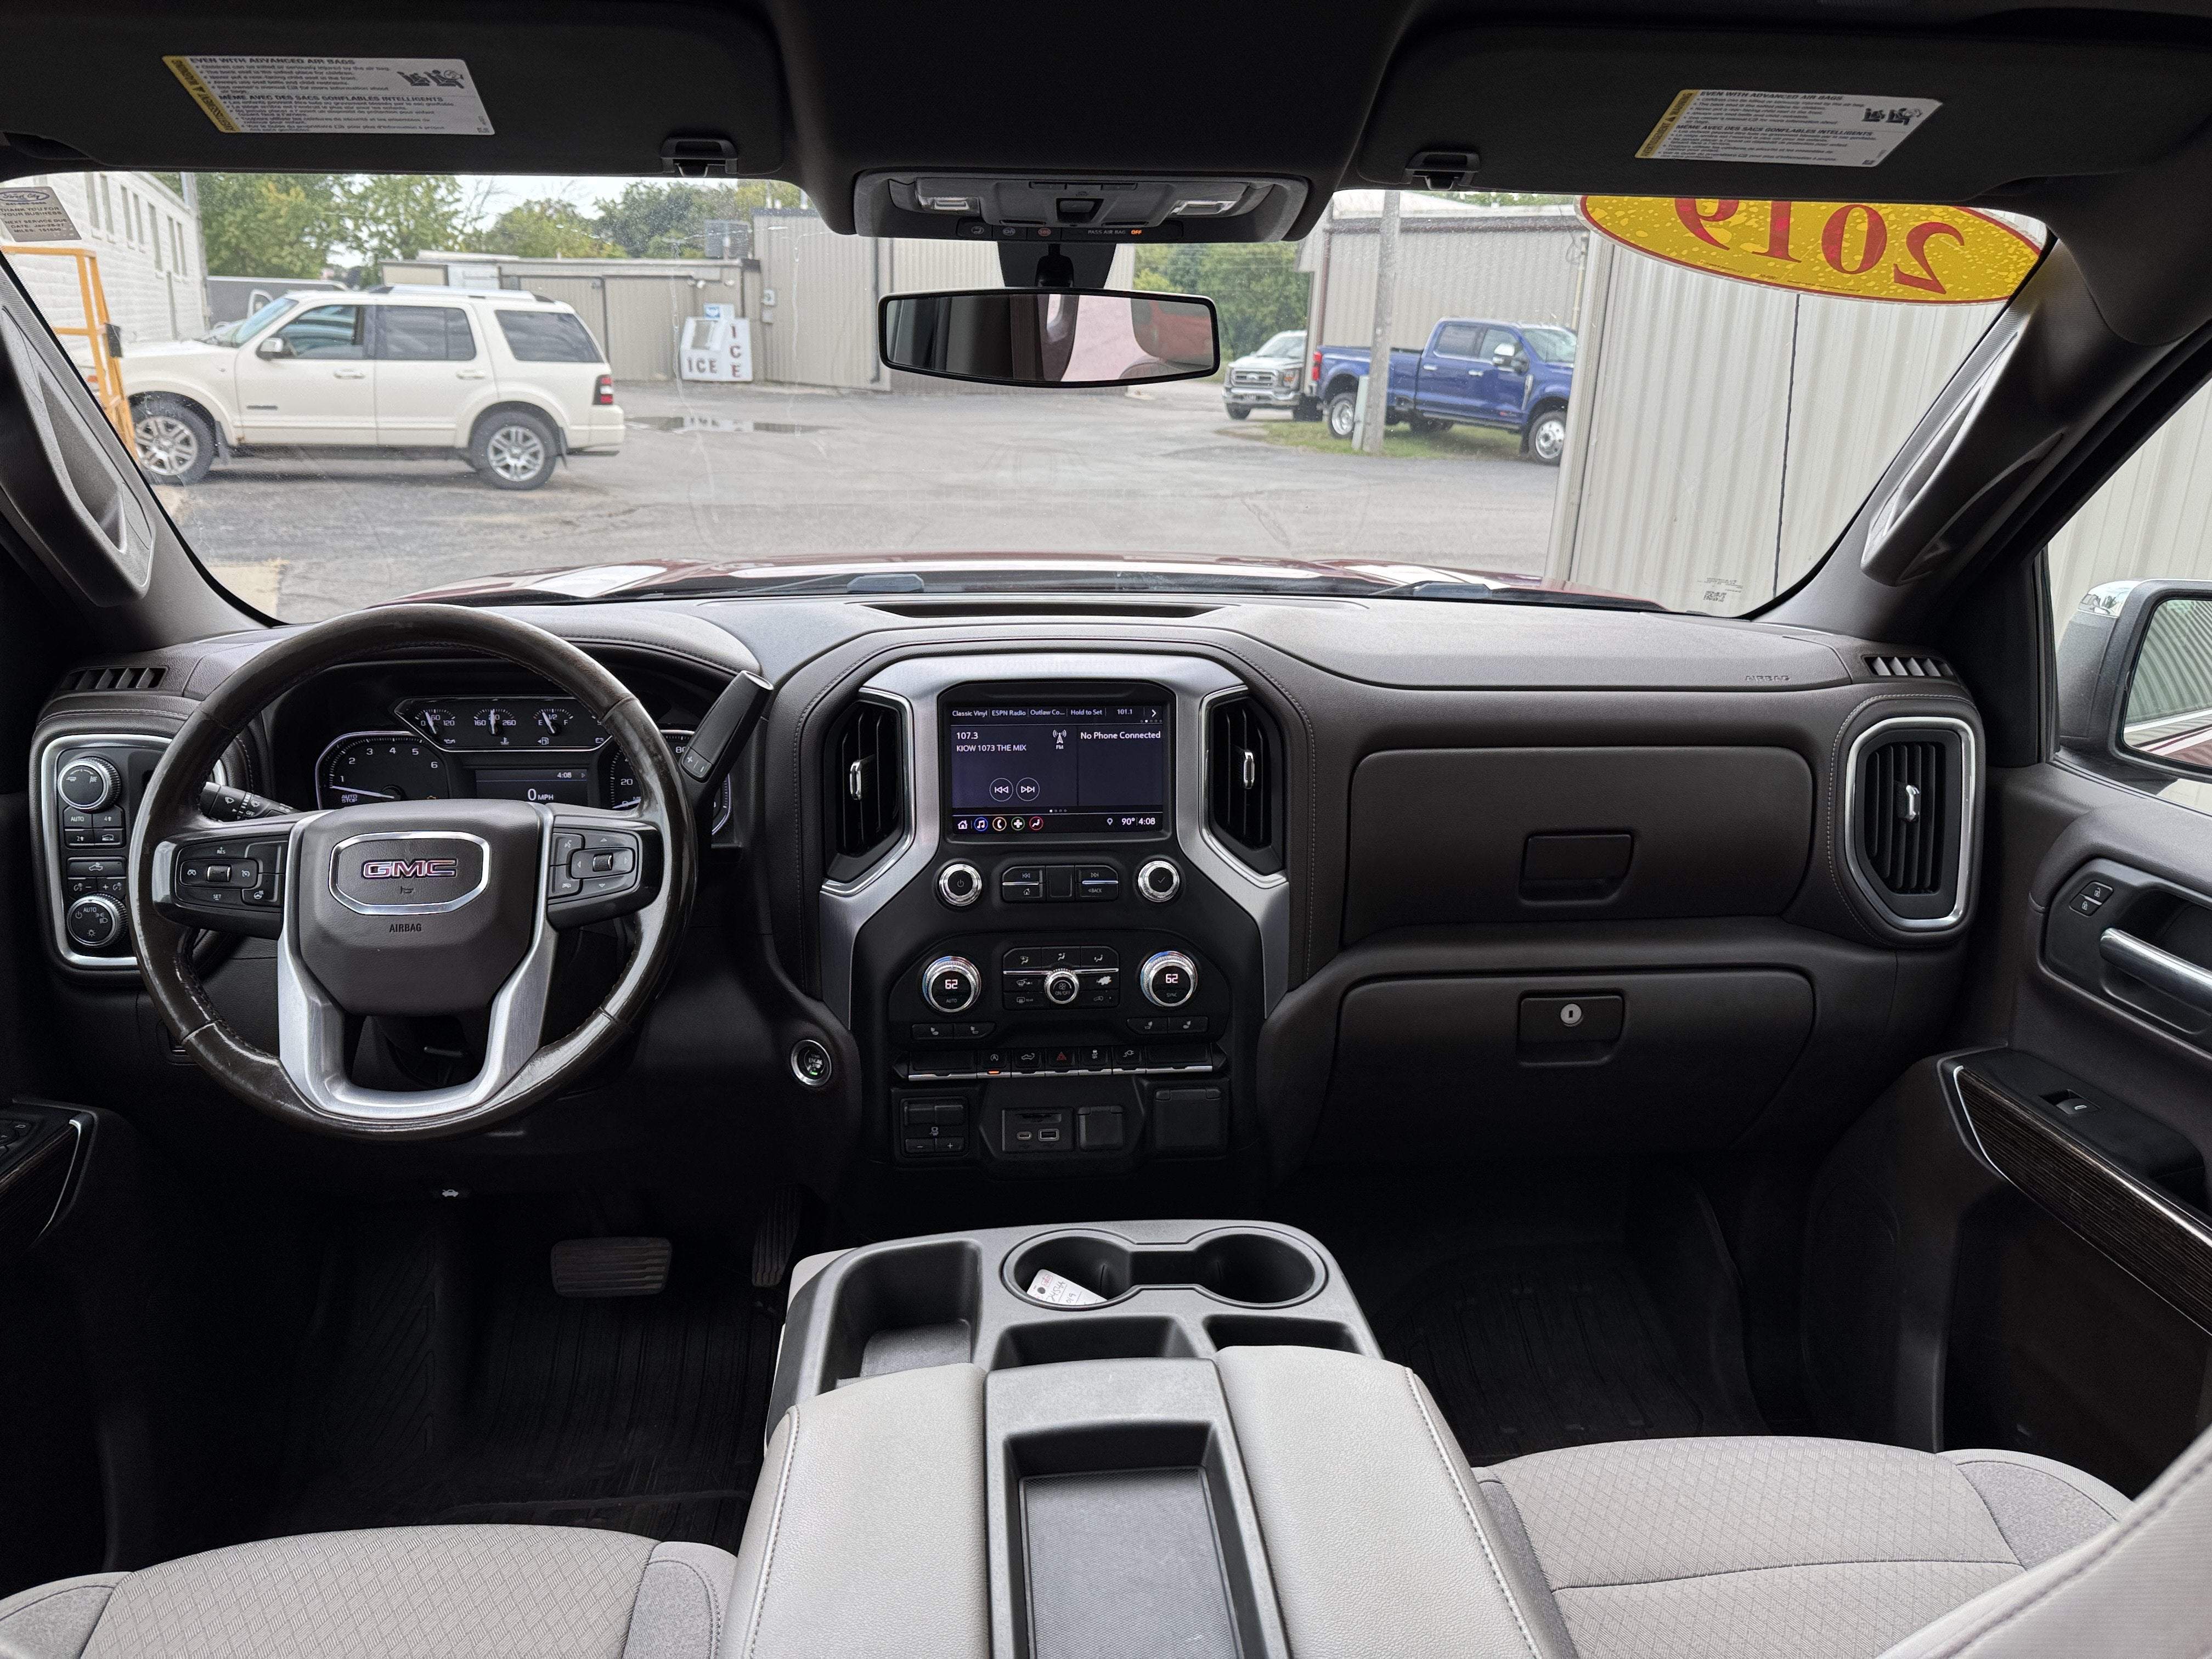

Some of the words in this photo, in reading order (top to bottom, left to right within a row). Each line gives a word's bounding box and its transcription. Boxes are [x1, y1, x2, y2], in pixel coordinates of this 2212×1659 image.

[730, 323, 742, 378] ICE
[687, 357, 718, 374] ICE
[528, 788, 537, 801] 0
[362, 859, 456, 878] GMC
[389, 923, 422, 933] AIRBAG
[945, 979, 958, 989] 62
[1165, 974, 1178, 983] 62
